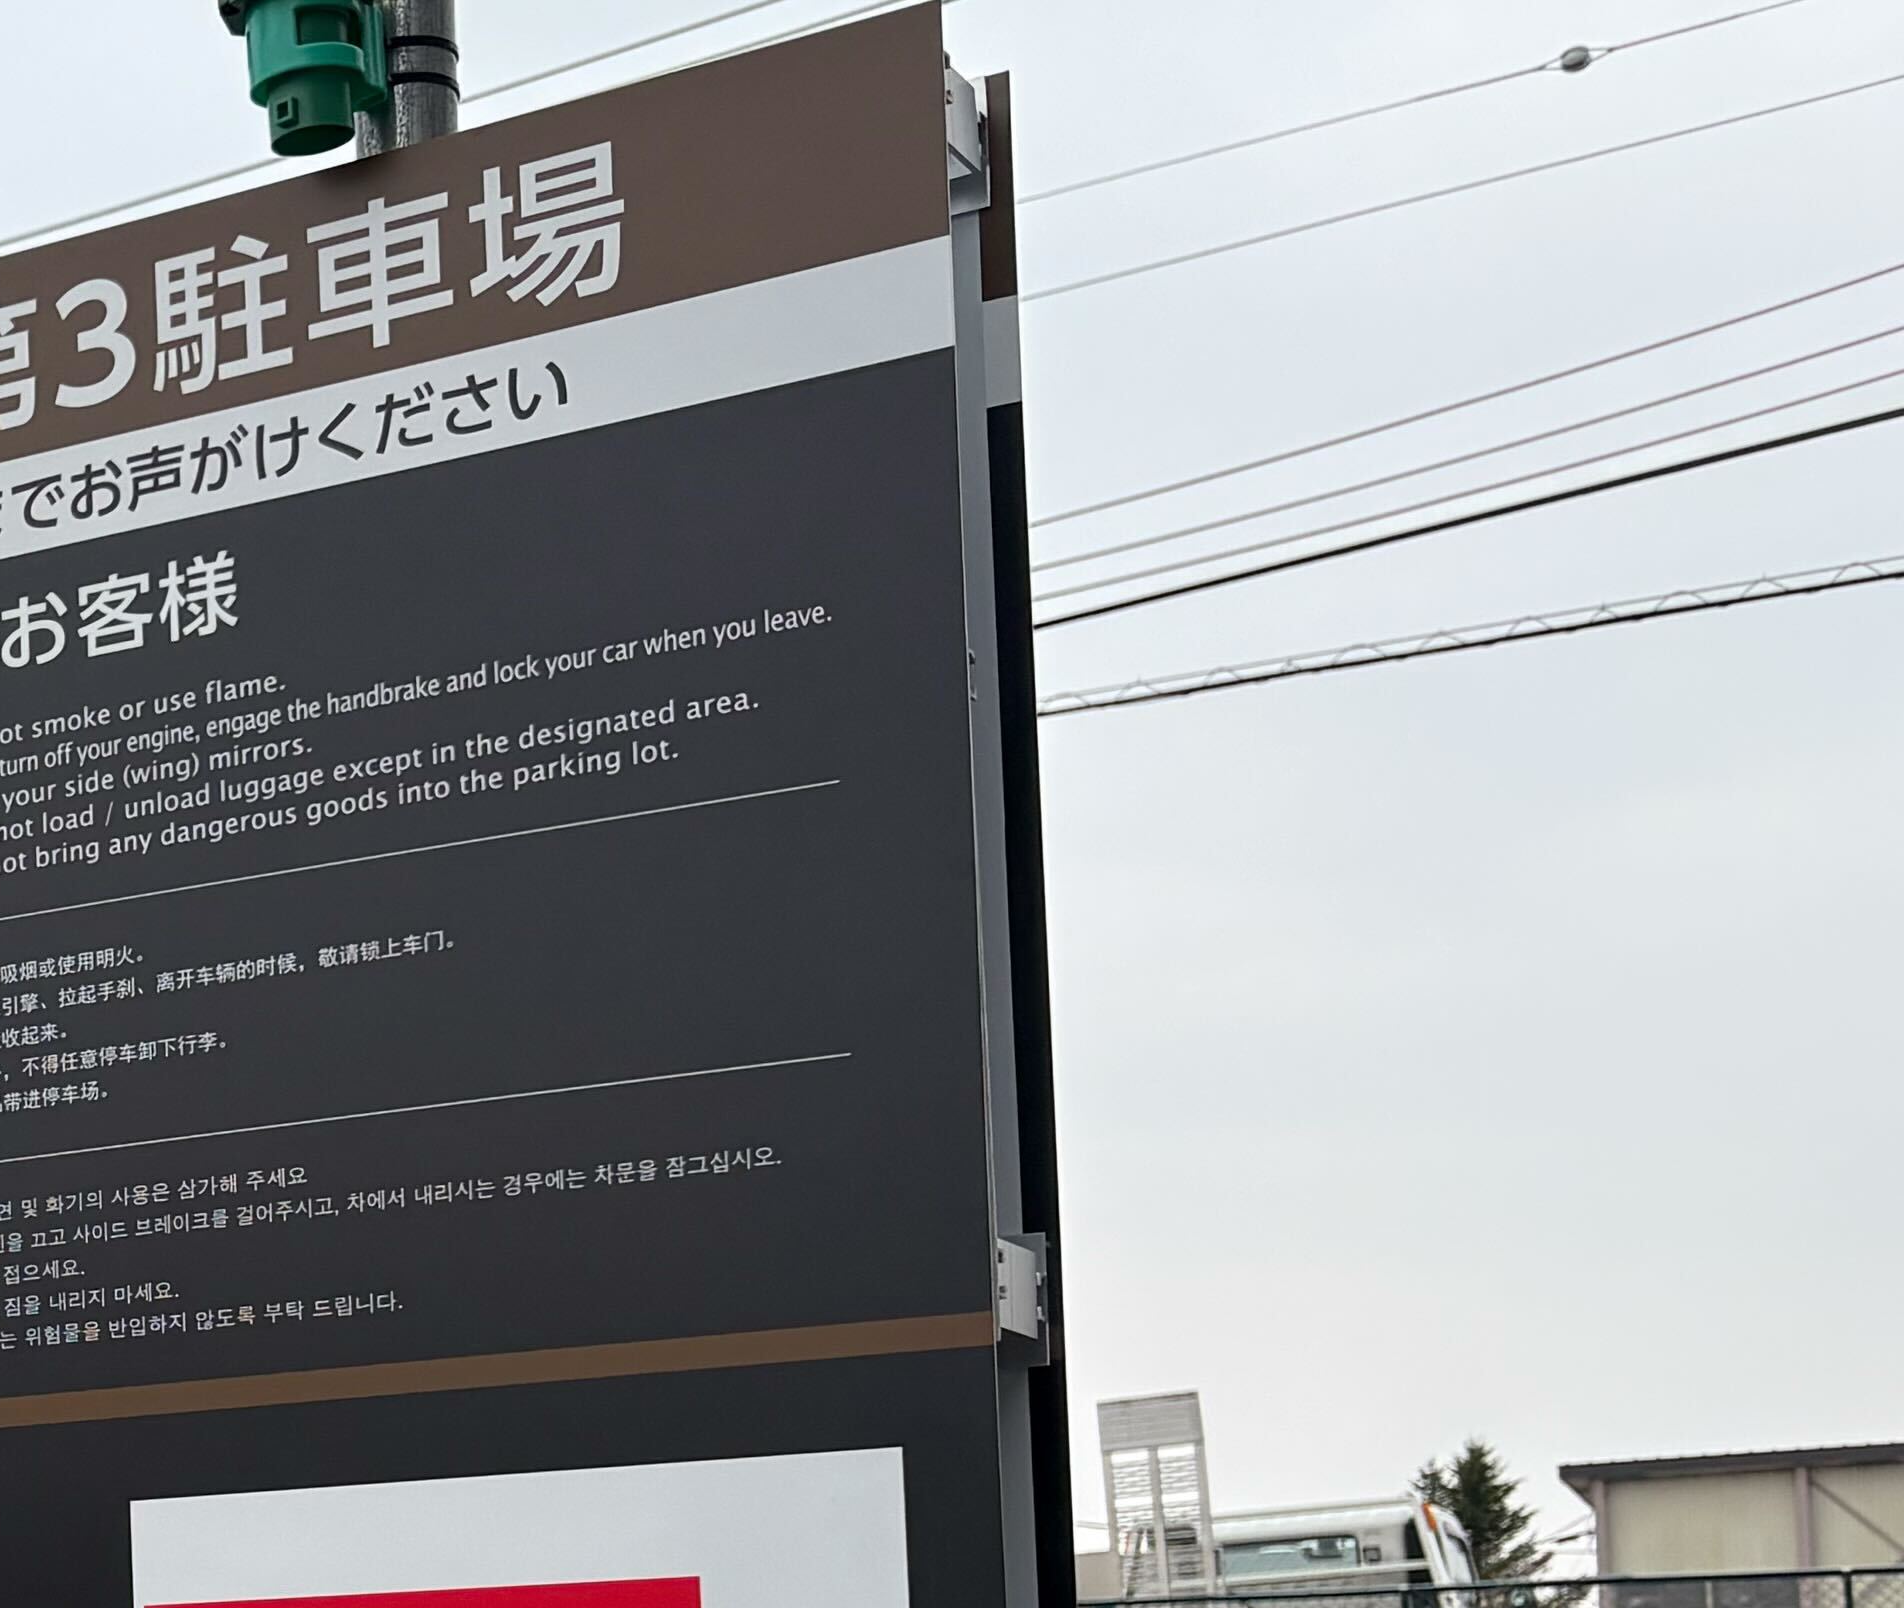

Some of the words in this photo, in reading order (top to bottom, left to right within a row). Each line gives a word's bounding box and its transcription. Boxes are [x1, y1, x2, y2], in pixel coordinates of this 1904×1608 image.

[31, 705, 111, 739] smoke
[119, 700, 146, 721] or
[153, 691, 196, 715] use
[205, 675, 286, 704] flame.
[44, 740, 74, 768] off
[76, 738, 122, 768] your
[126, 724, 201, 754] engine,
[206, 708, 282, 739] engage
[287, 697, 321, 723] the
[326, 675, 441, 715] handbrake
[446, 663, 487, 693] and
[494, 654, 540, 684] lock
[544, 647, 597, 680] your
[602, 640, 638, 664] car
[643, 627, 707, 656] when
[712, 619, 756, 649] you
[764, 605, 832, 634] leave.
[1, 783, 57, 814] your
[64, 769, 115, 798] side
[123, 751, 200, 789] (wing)
[208, 737, 312, 771] mirrors.
[42, 803, 95, 835] load
[104, 801, 114, 826] /
[125, 781, 210, 820] unload
[220, 768, 325, 804] luggage
[332, 748, 423, 782] except
[432, 742, 455, 765] in
[464, 733, 509, 759] the
[518, 698, 675, 750] designated
[686, 692, 759, 720] area.
[35, 841, 100, 868] bring
[108, 832, 153, 856] any
[160, 806, 297, 846] dangerous
[306, 787, 388, 826] goods
[398, 780, 450, 805] into
[459, 769, 503, 795] the
[513, 750, 621, 791] parking
[632, 739, 679, 766] lot.
[20, 1197, 38, 1219] 및
[45, 1189, 103, 1215] 화기의
[111, 1182, 171, 1207] 사용은
[177, 1172, 238, 1201] 삼가해
[246, 1166, 308, 1191] 주세요
[30, 1228, 67, 1248] 끄고
[72, 1221, 129, 1244] 사이드
[134, 1208, 229, 1236] 브레이크를
[236, 1196, 340, 1227] 걸어주시고,
[347, 1186, 405, 1213] 차에서
[414, 1179, 496, 1206] 내리시는
[503, 1168, 587, 1197] 경우에는
[594, 1159, 658, 1185] 차문을
[666, 1146, 782, 1179] 잠그십시오.
[3, 1258, 85, 1286] 접으세요.
[4, 1294, 42, 1317] 짐을
[49, 1287, 106, 1312] 내리지
[113, 1281, 179, 1305] 마세요.
[24, 1320, 101, 1346] 위험물을
[108, 1311, 187, 1339] 반입하지
[195, 1305, 256, 1331] 않도록
[263, 1300, 305, 1323] 부탁
[312, 1290, 404, 1317] 드립니다.
